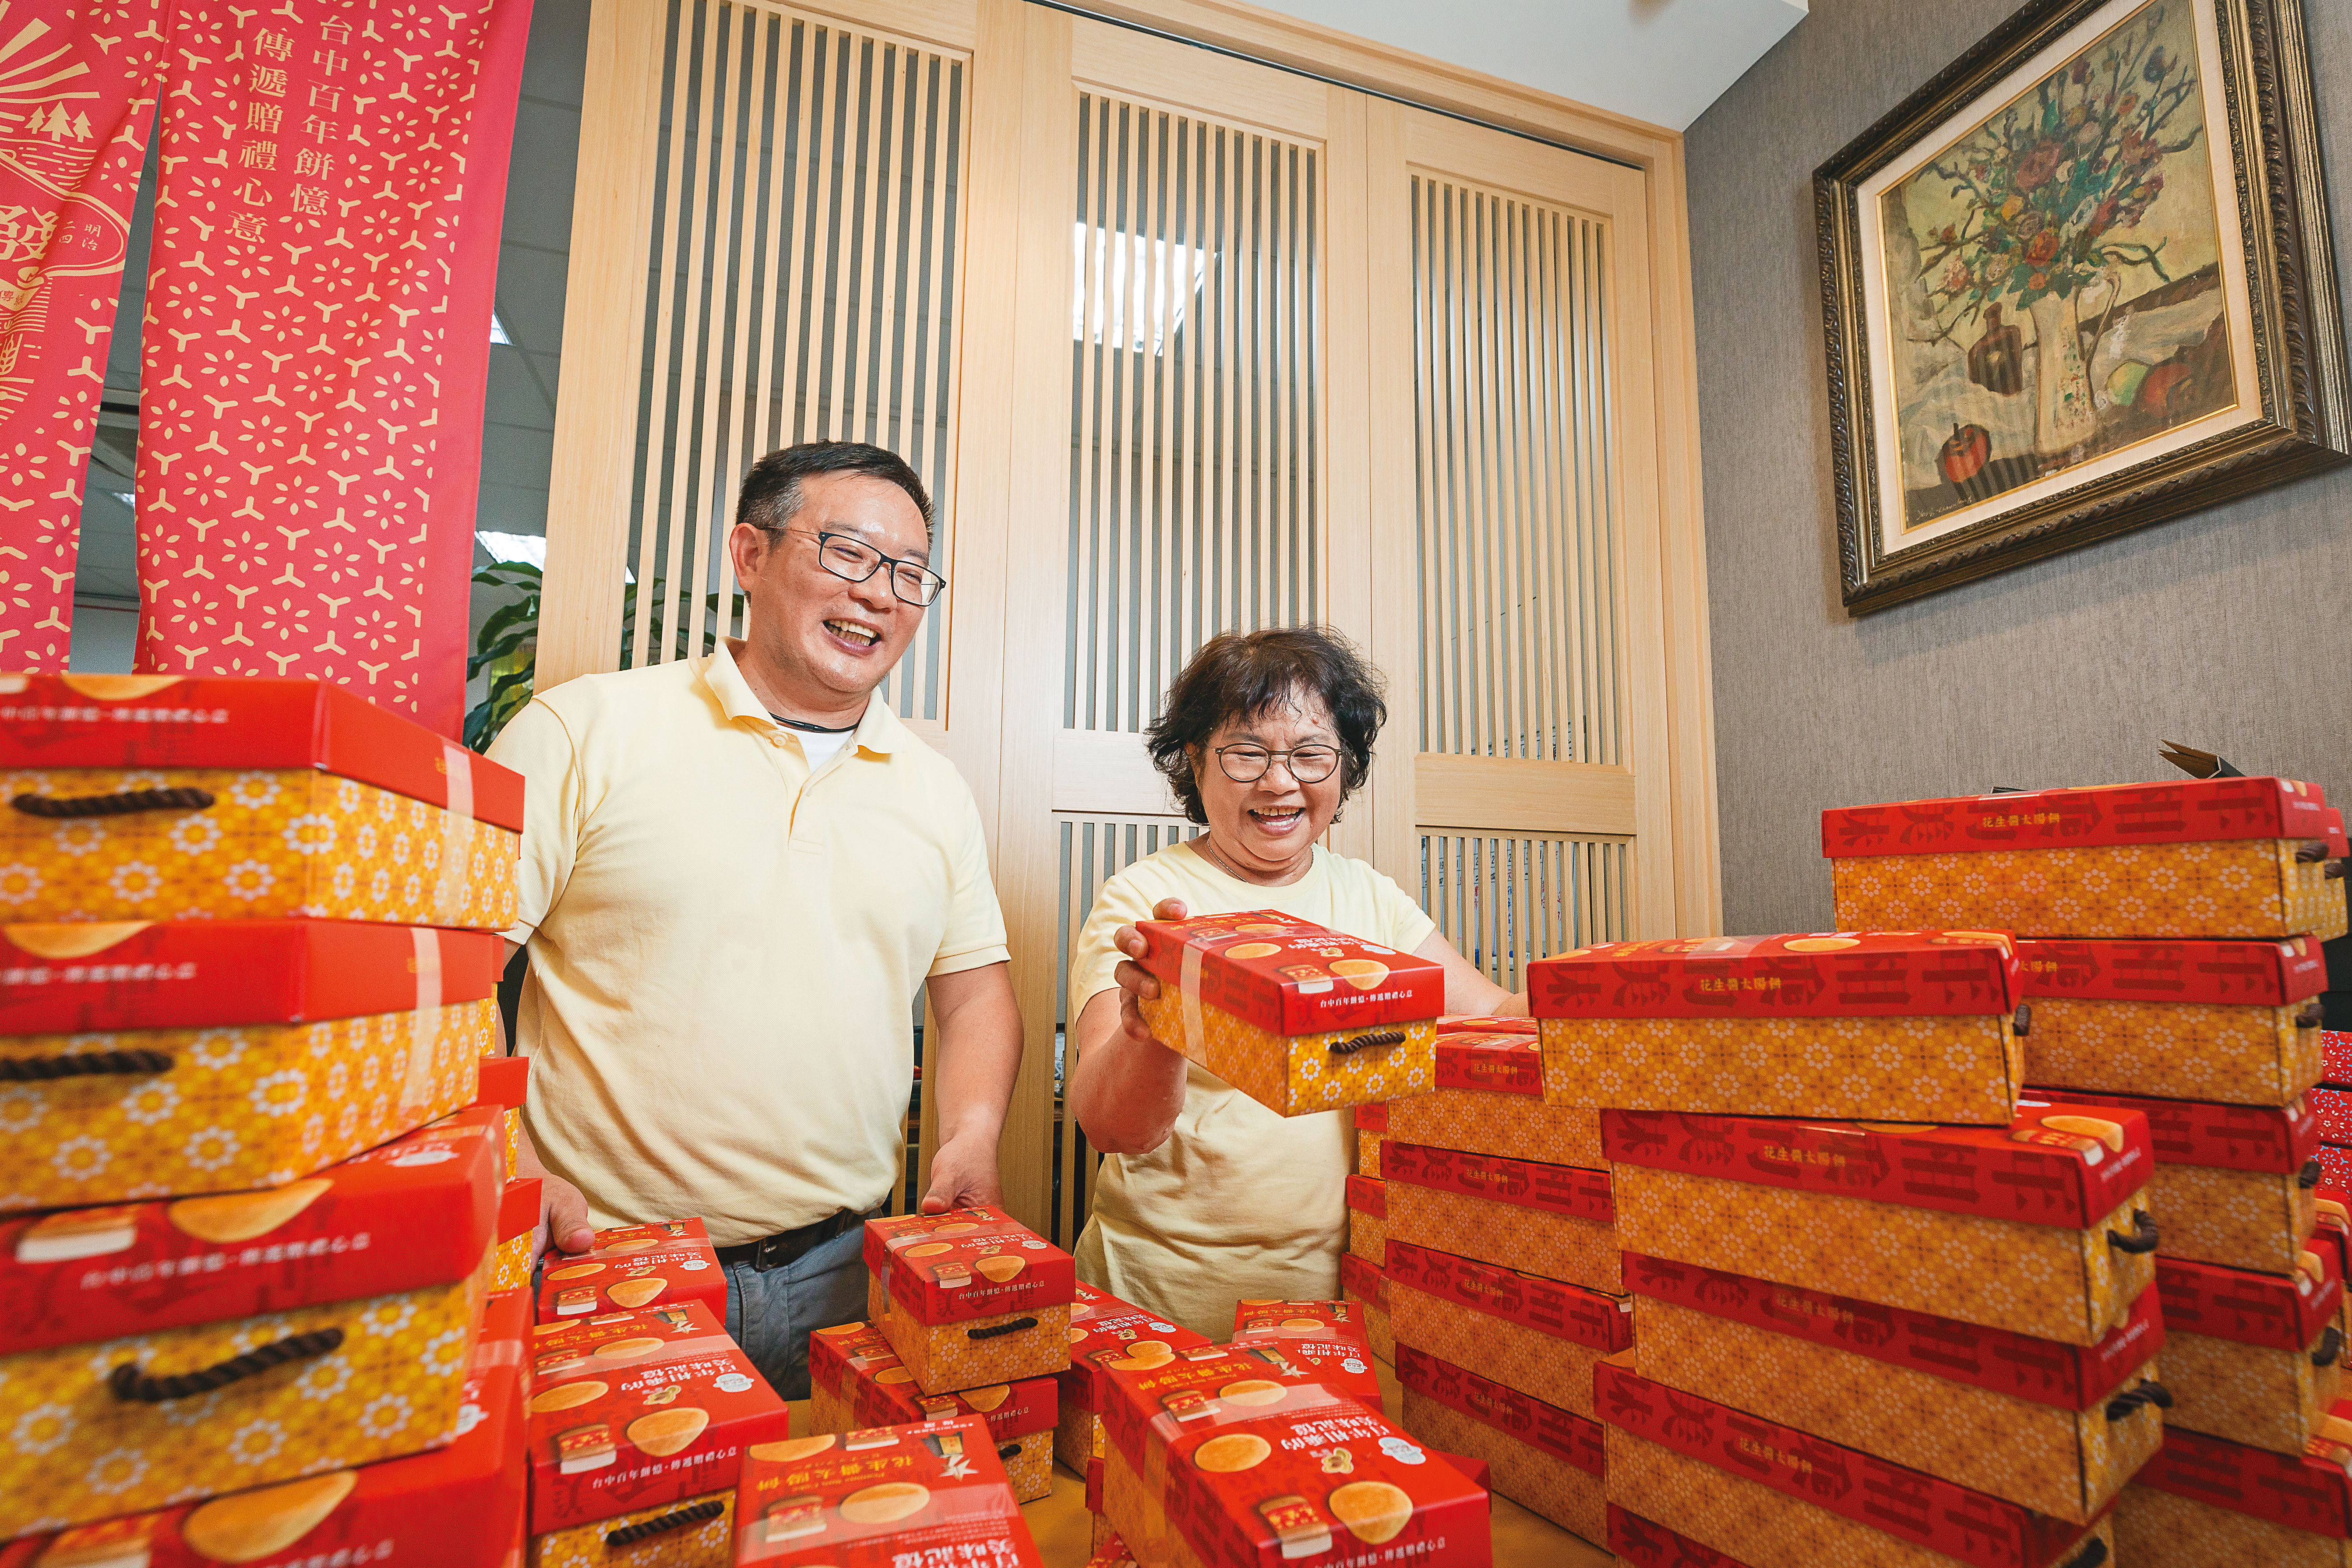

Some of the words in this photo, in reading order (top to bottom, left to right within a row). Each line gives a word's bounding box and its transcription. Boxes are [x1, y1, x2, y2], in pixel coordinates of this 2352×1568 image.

[225, 28, 295, 244] 傳遞贈禮心意
[290, 15, 353, 217] 台中百年餅憶
[59, 221, 76, 244] 二四
[81, 224, 101, 251] 明治
